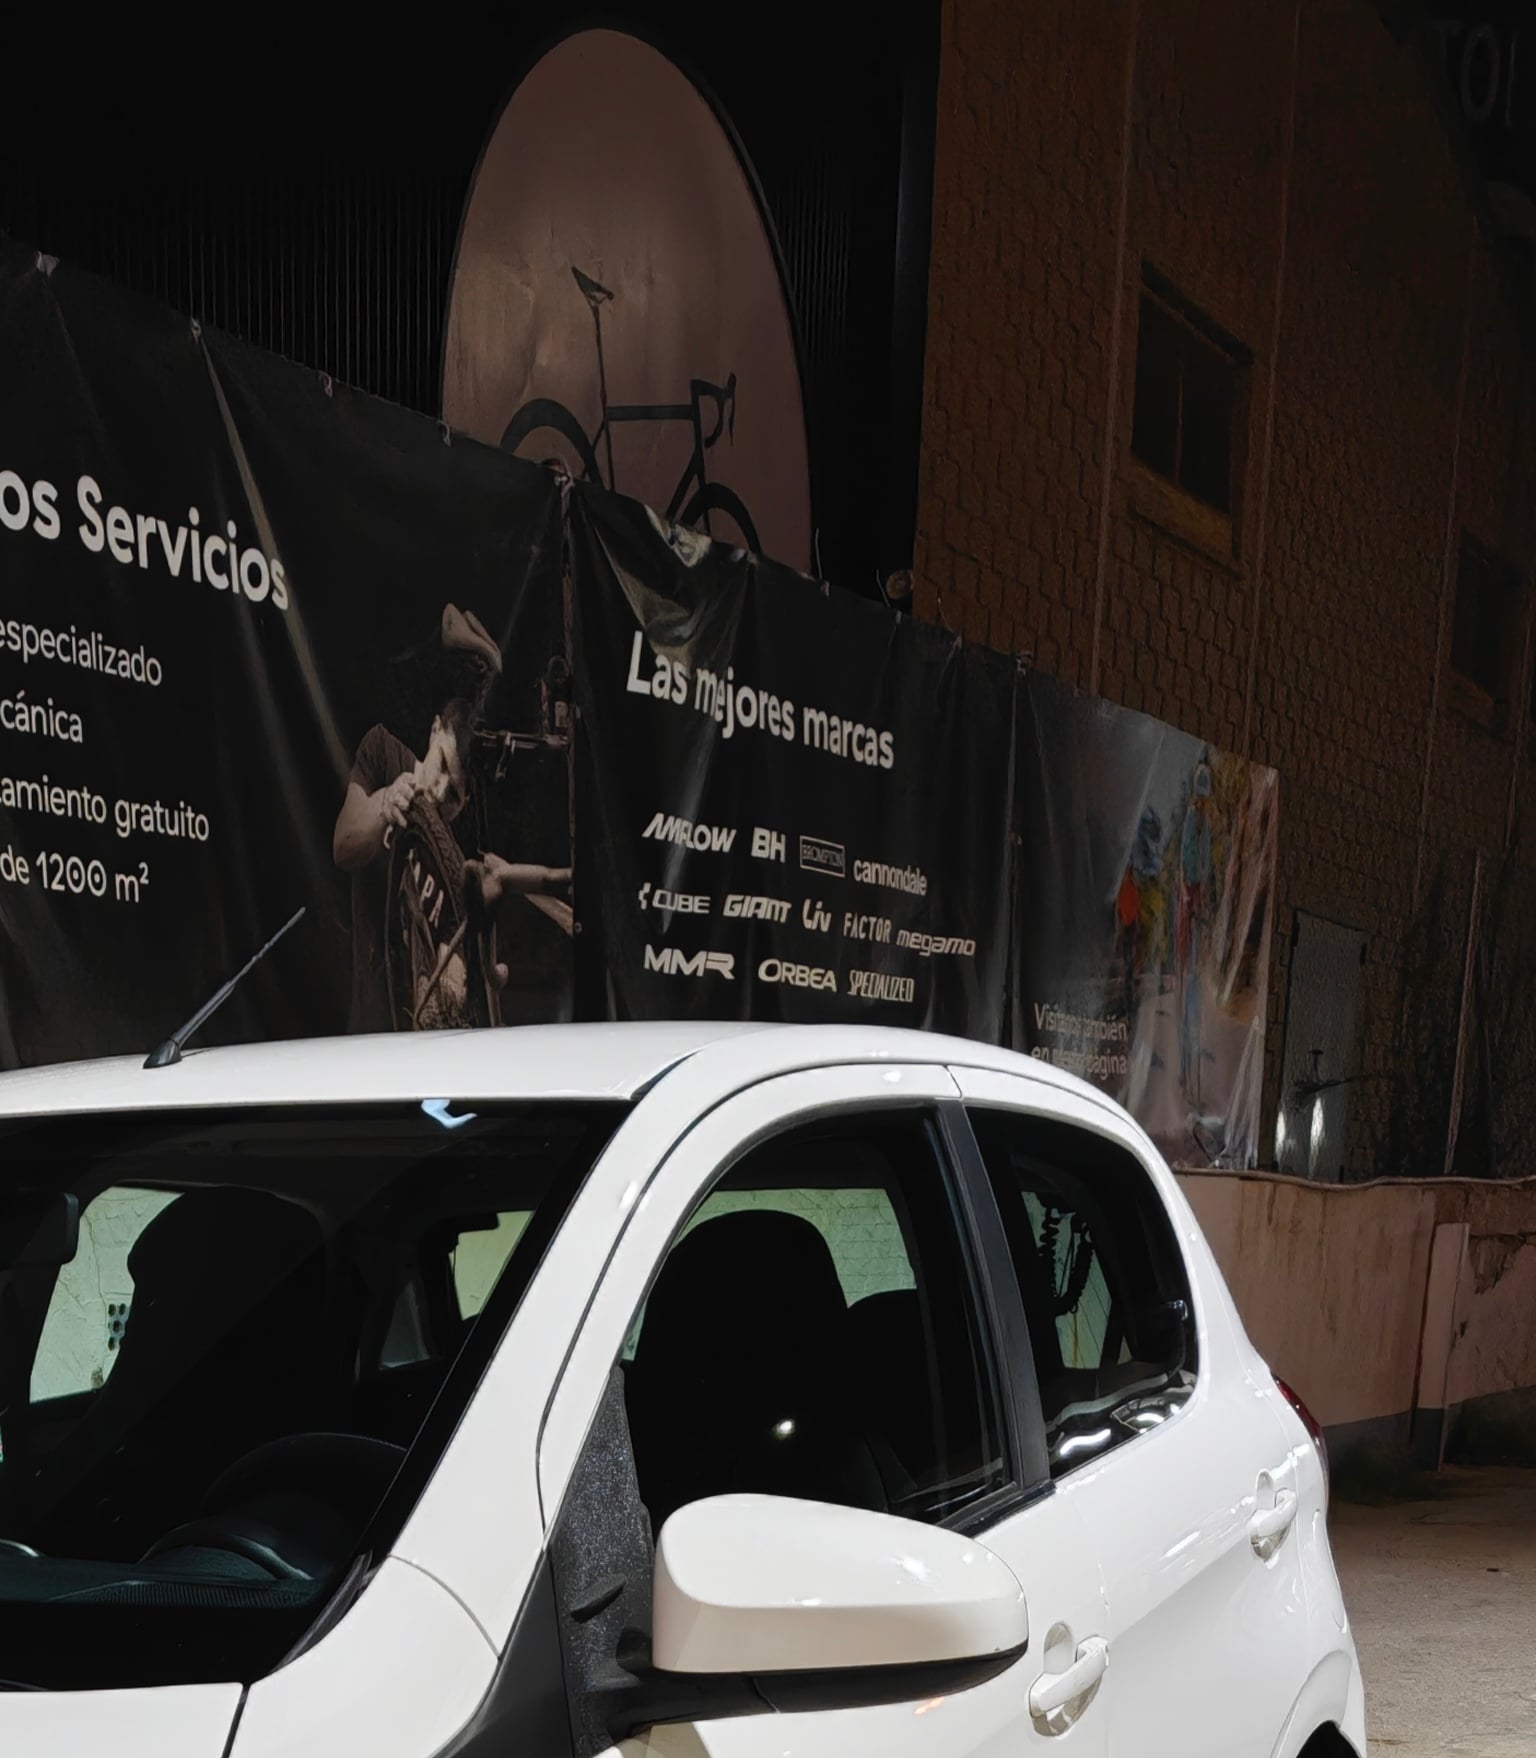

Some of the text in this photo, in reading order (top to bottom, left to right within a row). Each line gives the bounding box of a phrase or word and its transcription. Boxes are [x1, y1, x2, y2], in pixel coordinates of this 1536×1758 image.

[77, 474, 289, 610] Servicios
[626, 631, 895, 769] Las mejores marcas
[115, 798, 209, 842] gratuito
[0, 844, 30, 884] de
[35, 851, 107, 897] 1200
[115, 862, 149, 903] m²
[751, 828, 786, 863] BH
[853, 857, 928, 896] cannondale
[651, 889, 976, 957] CUBE GIANT Liv FACTOR megamo
[644, 944, 915, 1003] MMR ORBEA SPECIALIZED
